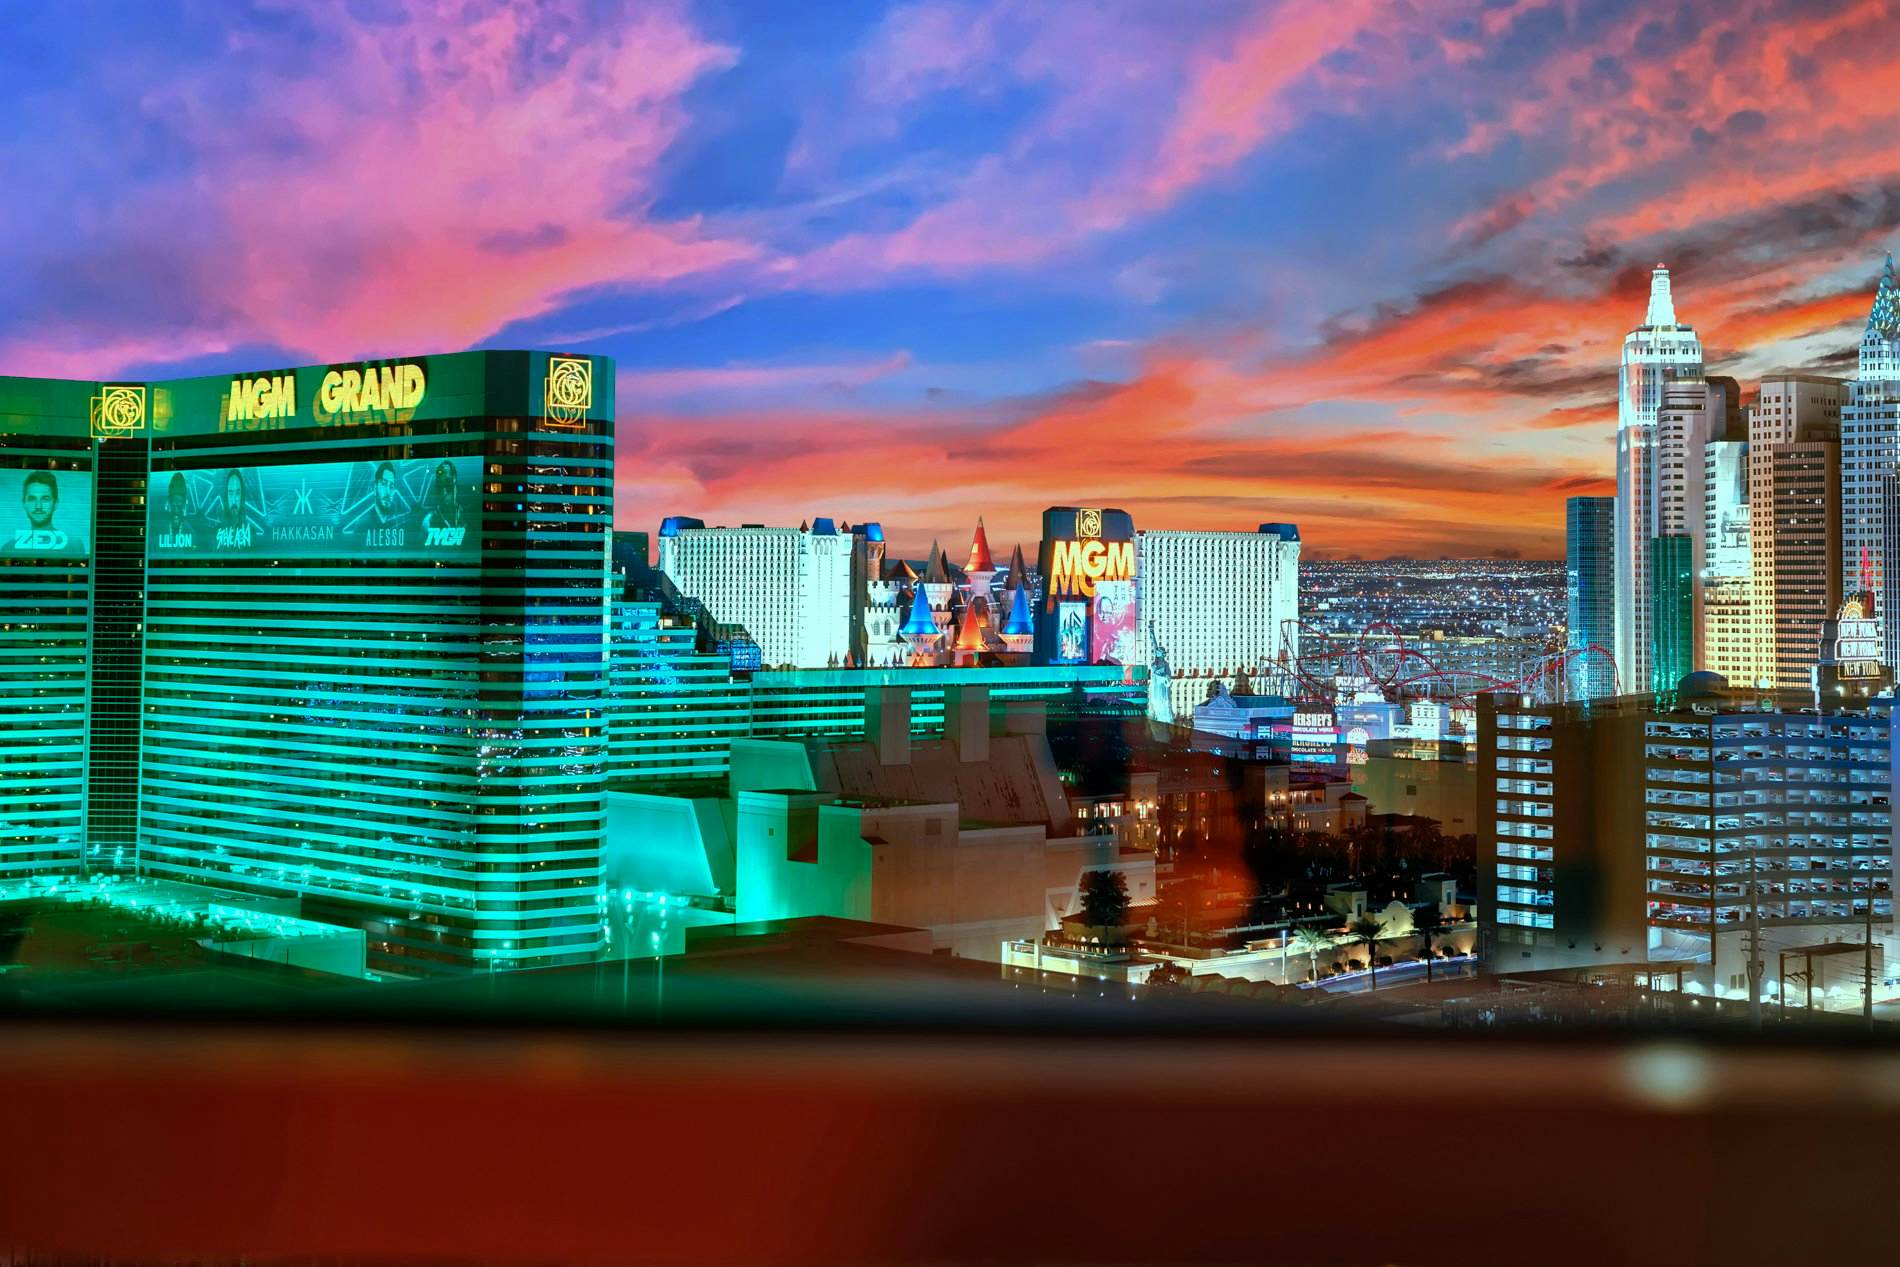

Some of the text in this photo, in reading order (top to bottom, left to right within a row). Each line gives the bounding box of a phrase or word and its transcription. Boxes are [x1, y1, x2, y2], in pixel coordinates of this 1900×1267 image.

[229, 364, 425, 421] MGM GRAND
[15, 529, 68, 550] ZEDD
[159, 534, 192, 548] LIL JON
[272, 526, 334, 541] HAKKASAN
[366, 528, 404, 546] ALESSO
[1051, 540, 1136, 577] MGM
[1844, 662, 1880, 676] NEW YORK
[1293, 713, 1332, 726] HERSHEY'S
